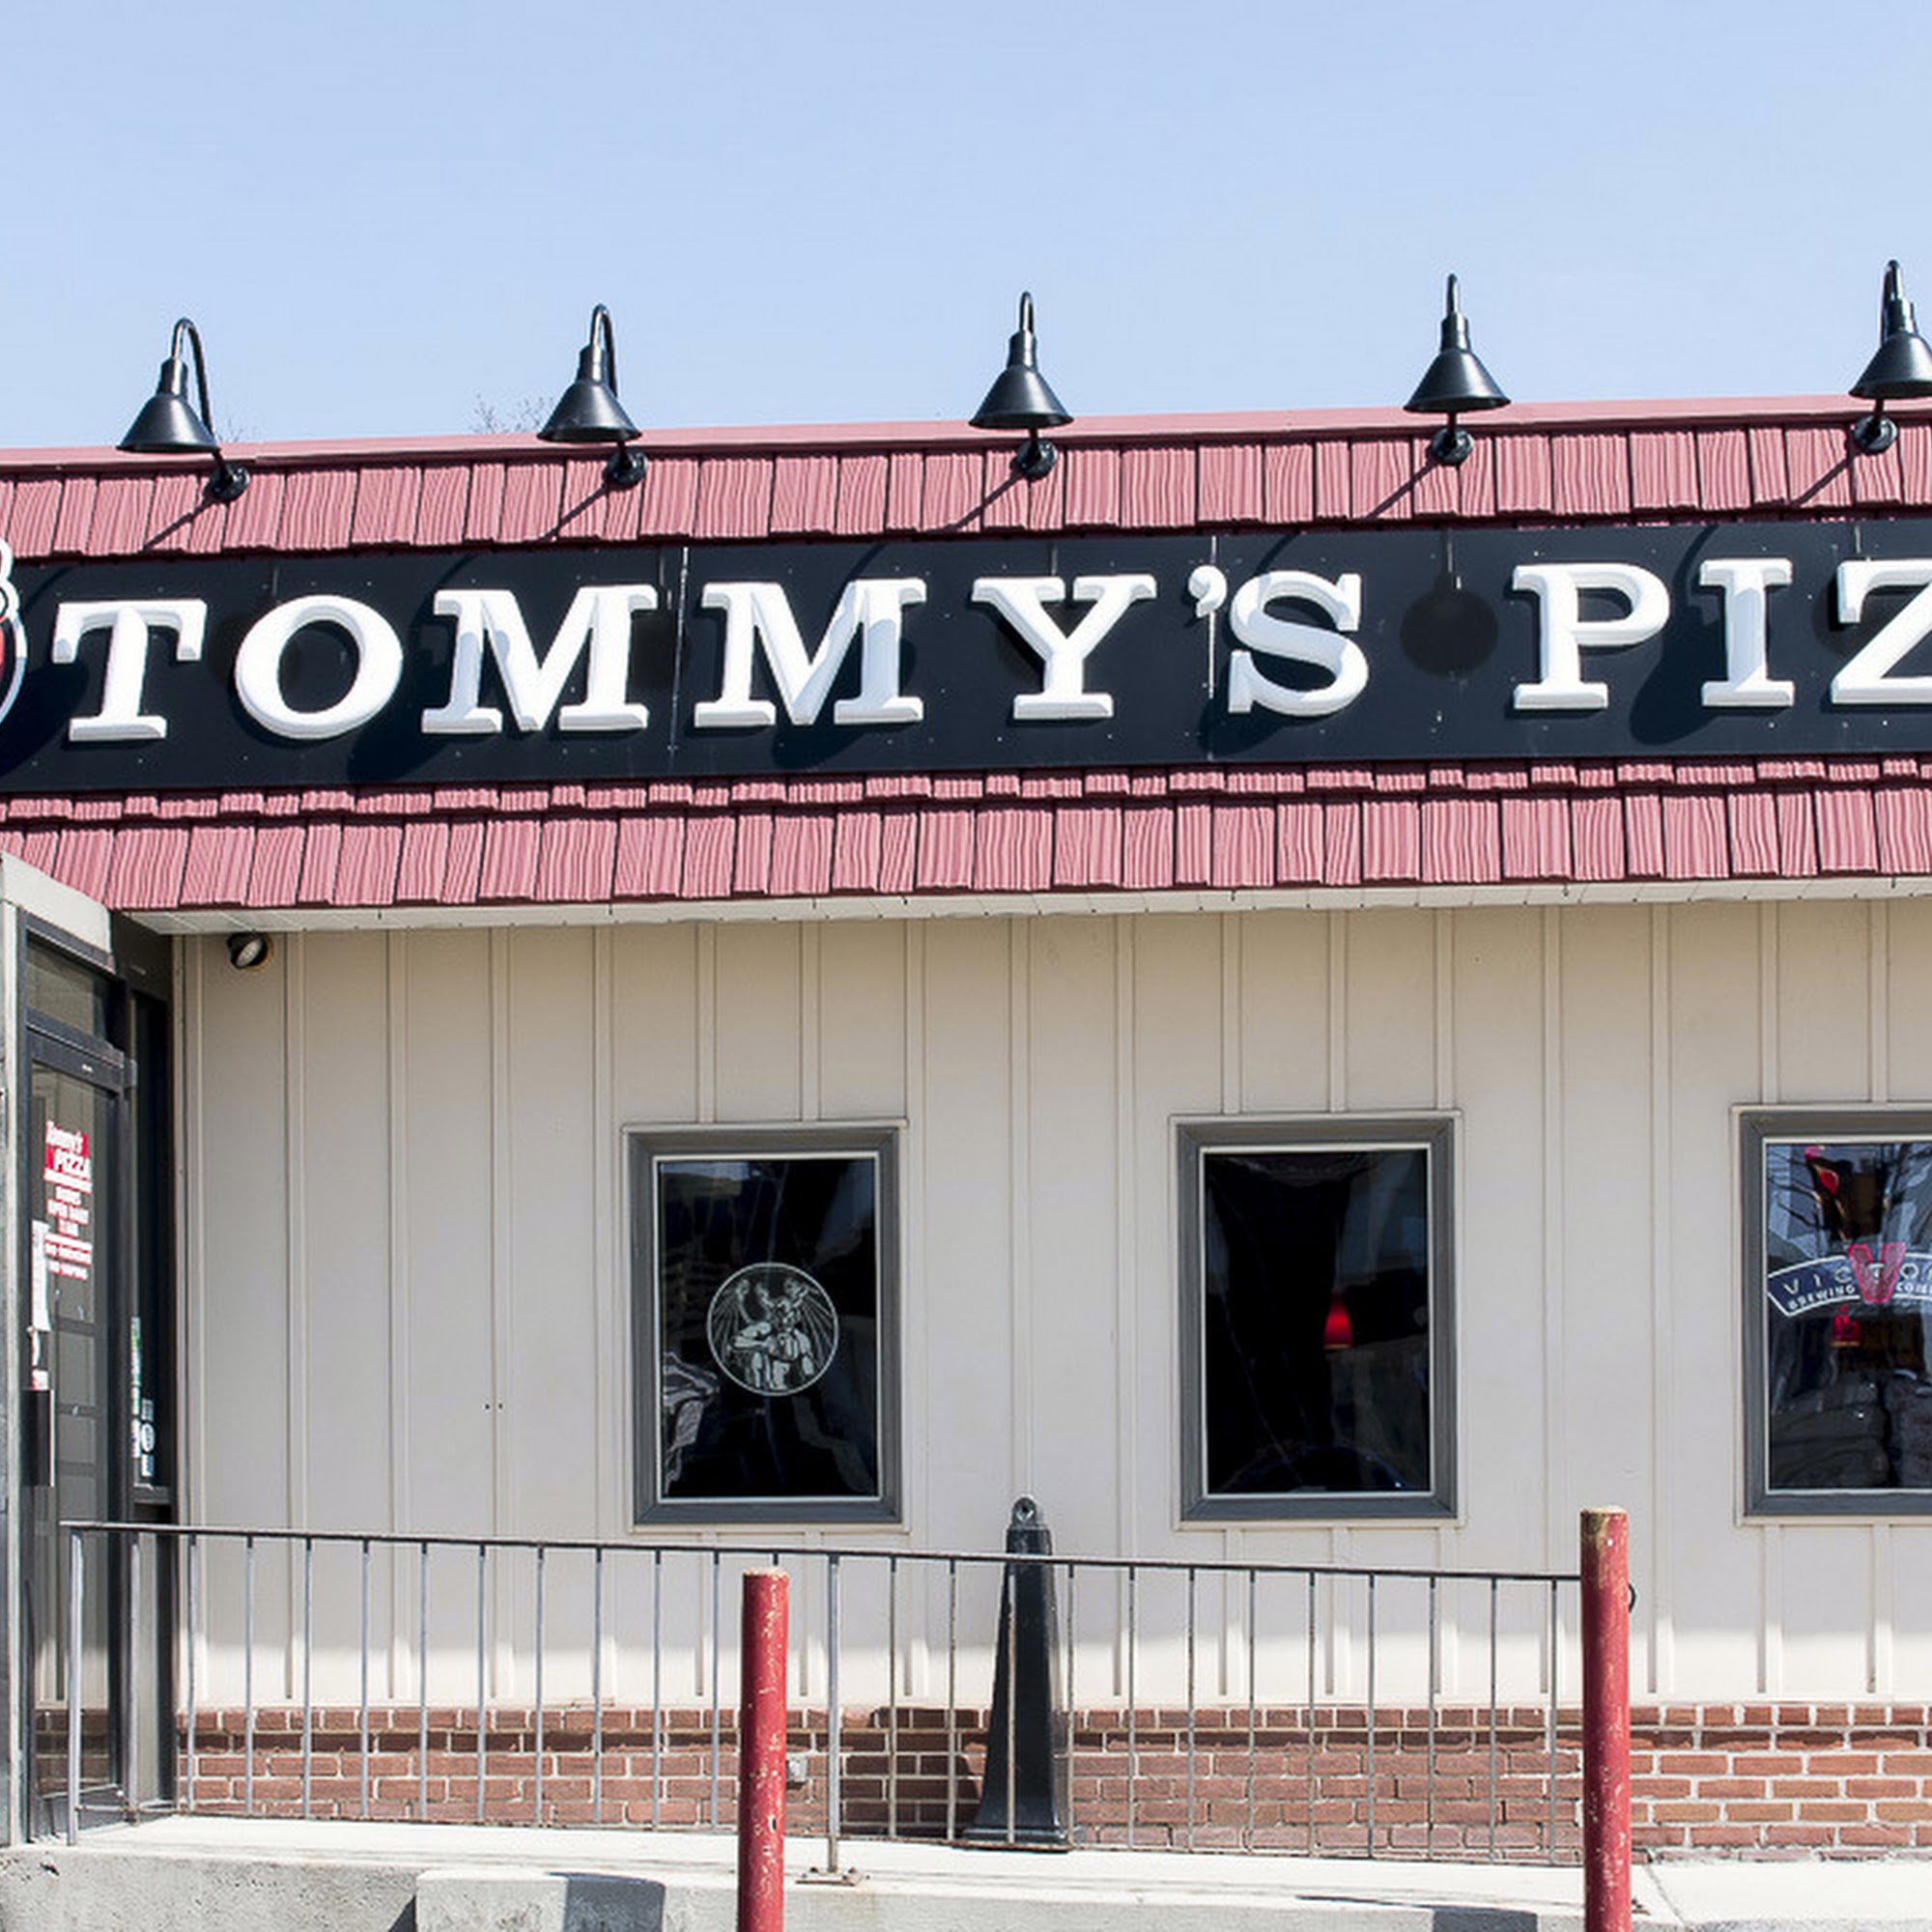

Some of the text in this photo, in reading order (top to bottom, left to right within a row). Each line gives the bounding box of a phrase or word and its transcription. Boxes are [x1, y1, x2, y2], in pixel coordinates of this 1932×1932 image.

[52, 565, 1369, 741] TOMMY'S
[1782, 1263, 1932, 1294] VICTO
[1788, 1285, 1856, 1311] BREWING
